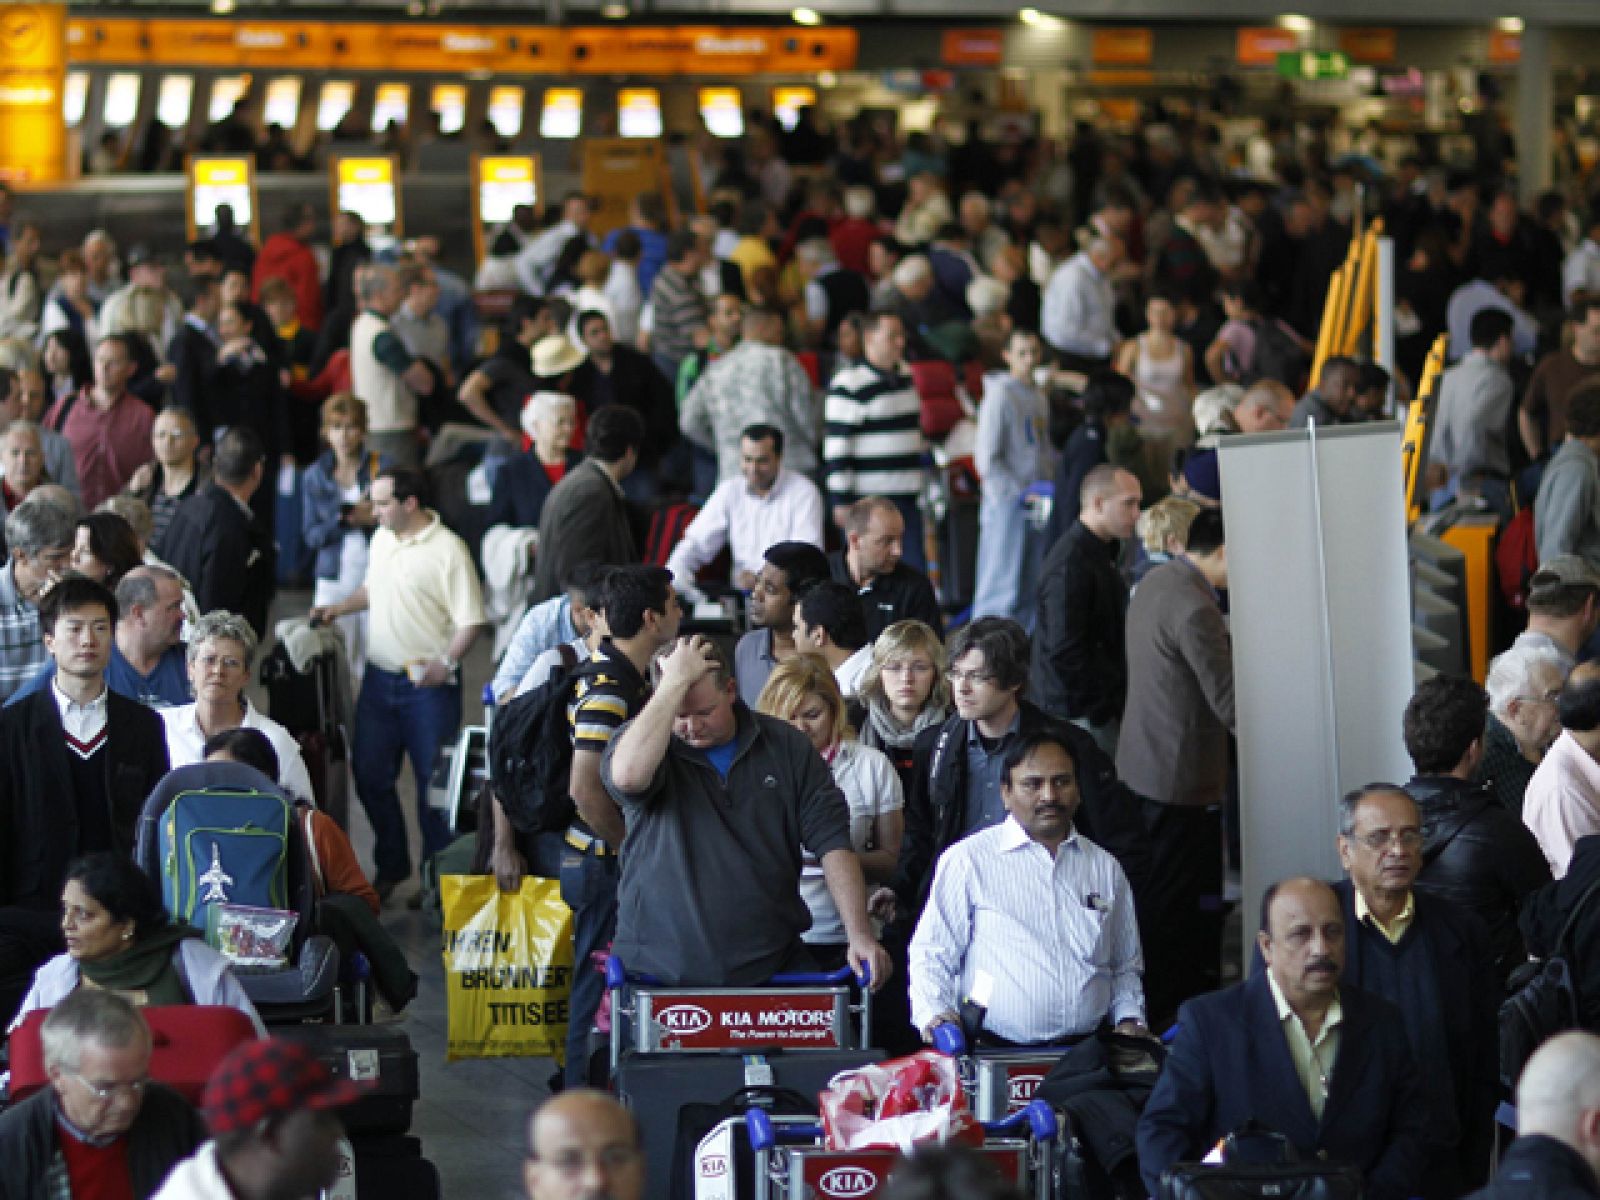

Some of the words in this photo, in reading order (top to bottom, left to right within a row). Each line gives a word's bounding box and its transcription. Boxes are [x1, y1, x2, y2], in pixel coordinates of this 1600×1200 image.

[461, 966, 574, 989] BRUNNER
[487, 1001, 570, 1026] TITISEE
[720, 1011, 753, 1026] KIA
[756, 1009, 836, 1026] MOTORS
